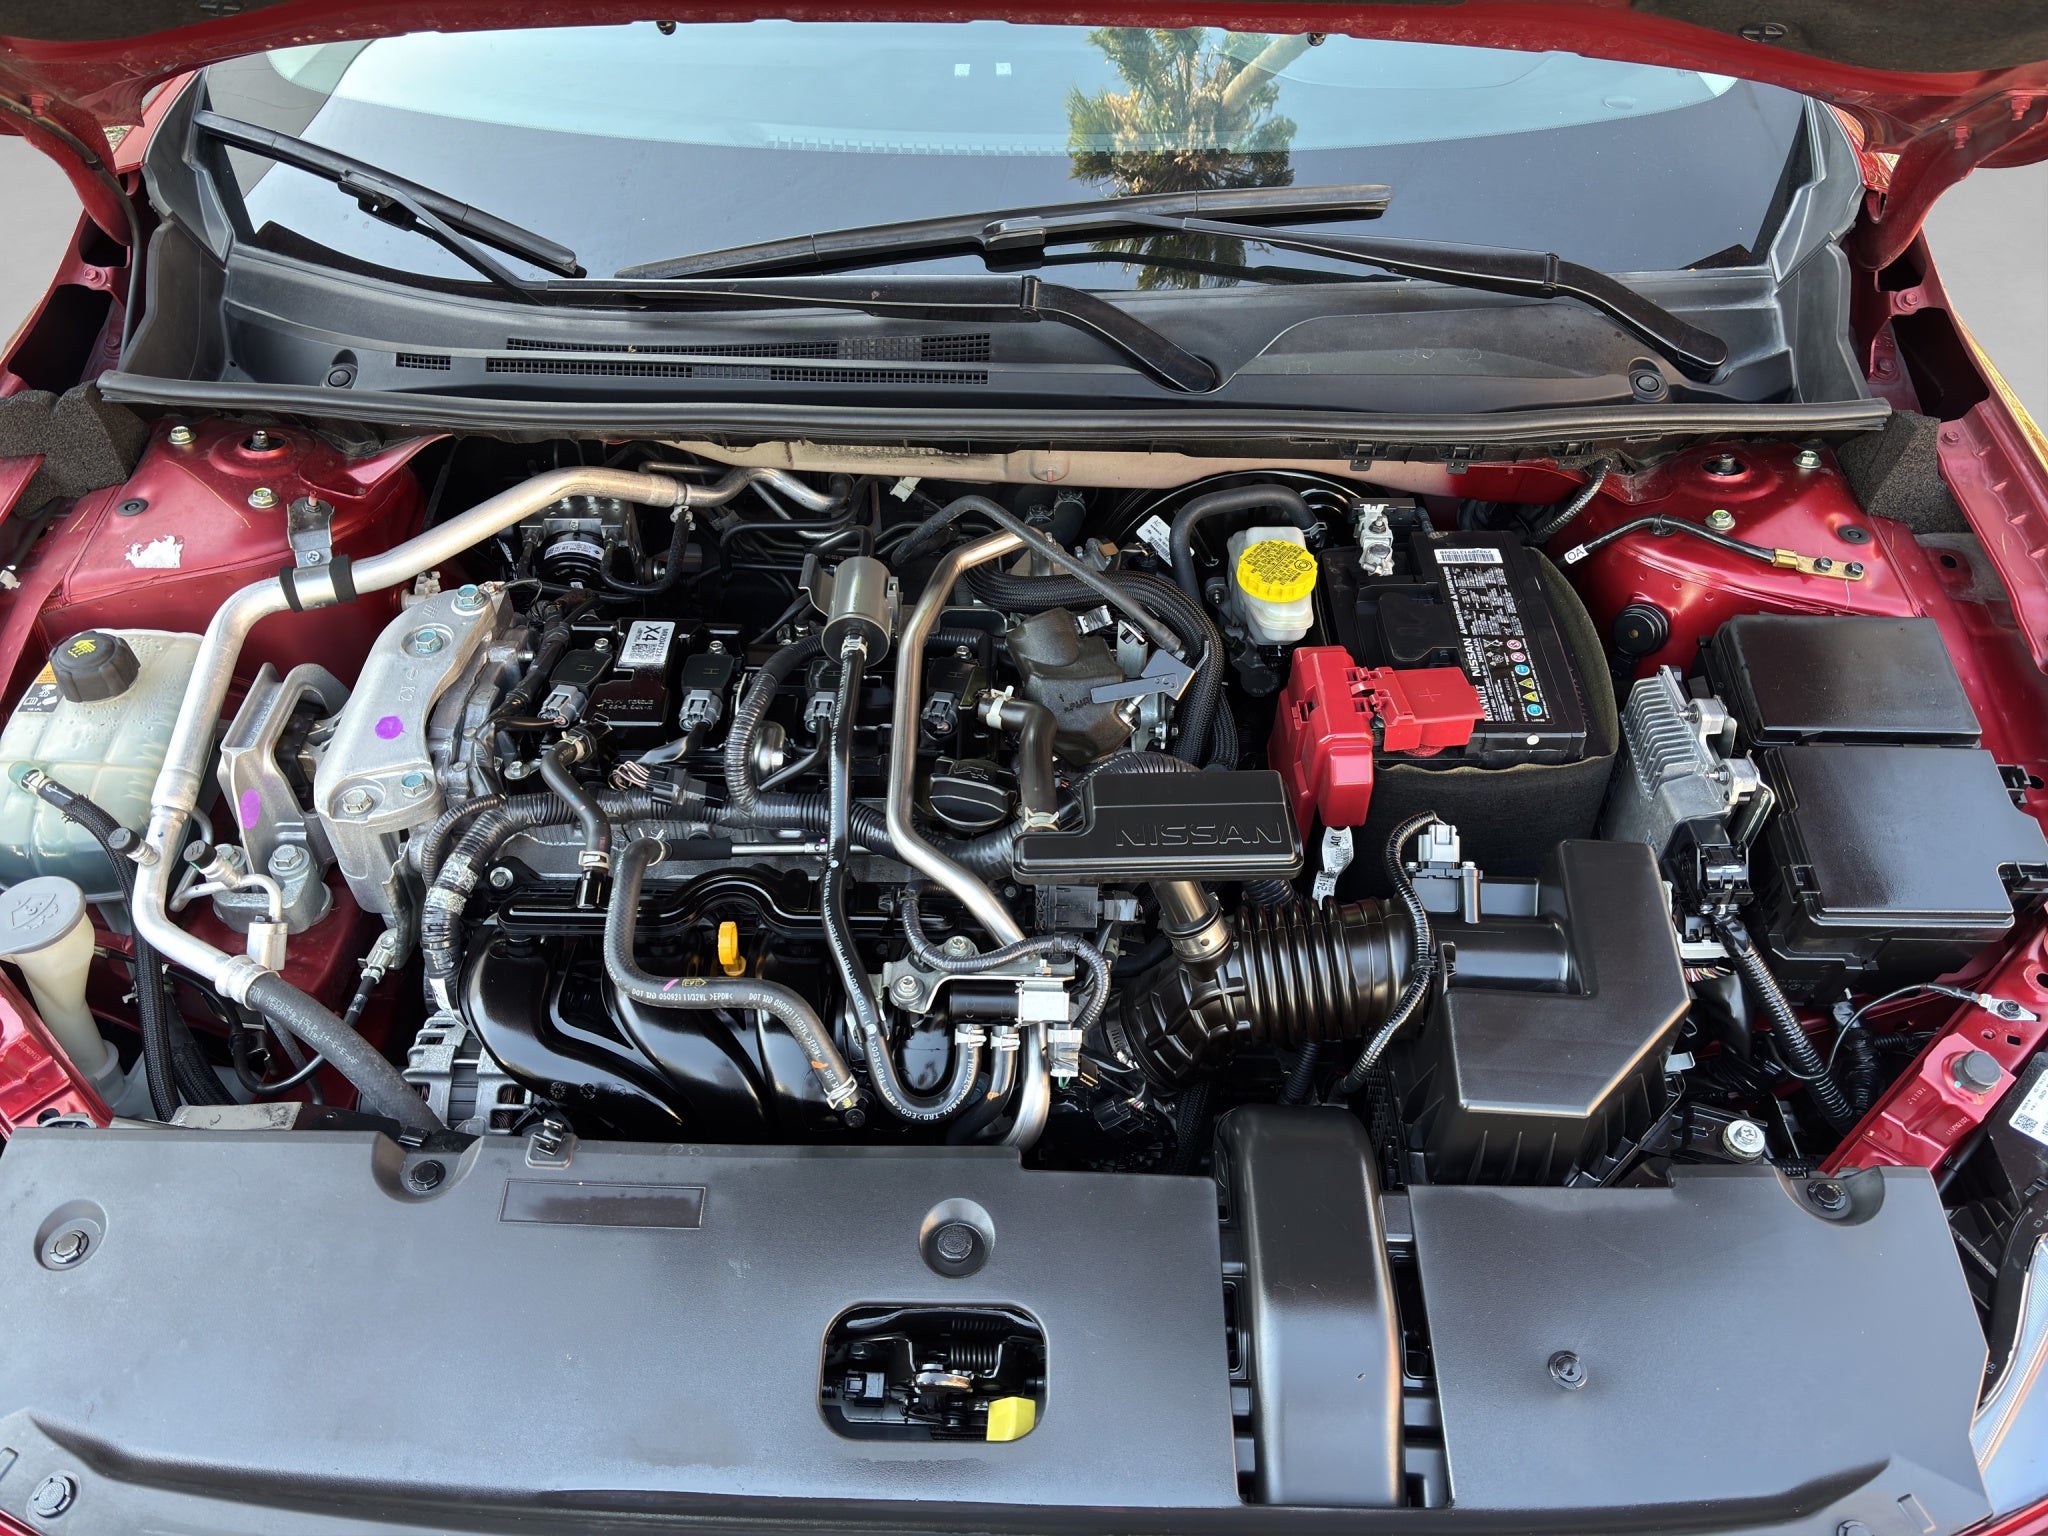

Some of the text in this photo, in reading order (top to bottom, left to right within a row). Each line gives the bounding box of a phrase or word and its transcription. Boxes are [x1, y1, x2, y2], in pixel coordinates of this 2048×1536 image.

[642, 625, 662, 641] X4
[1462, 637, 1482, 677] NISSAN
[1115, 821, 1283, 847] NISSAN
